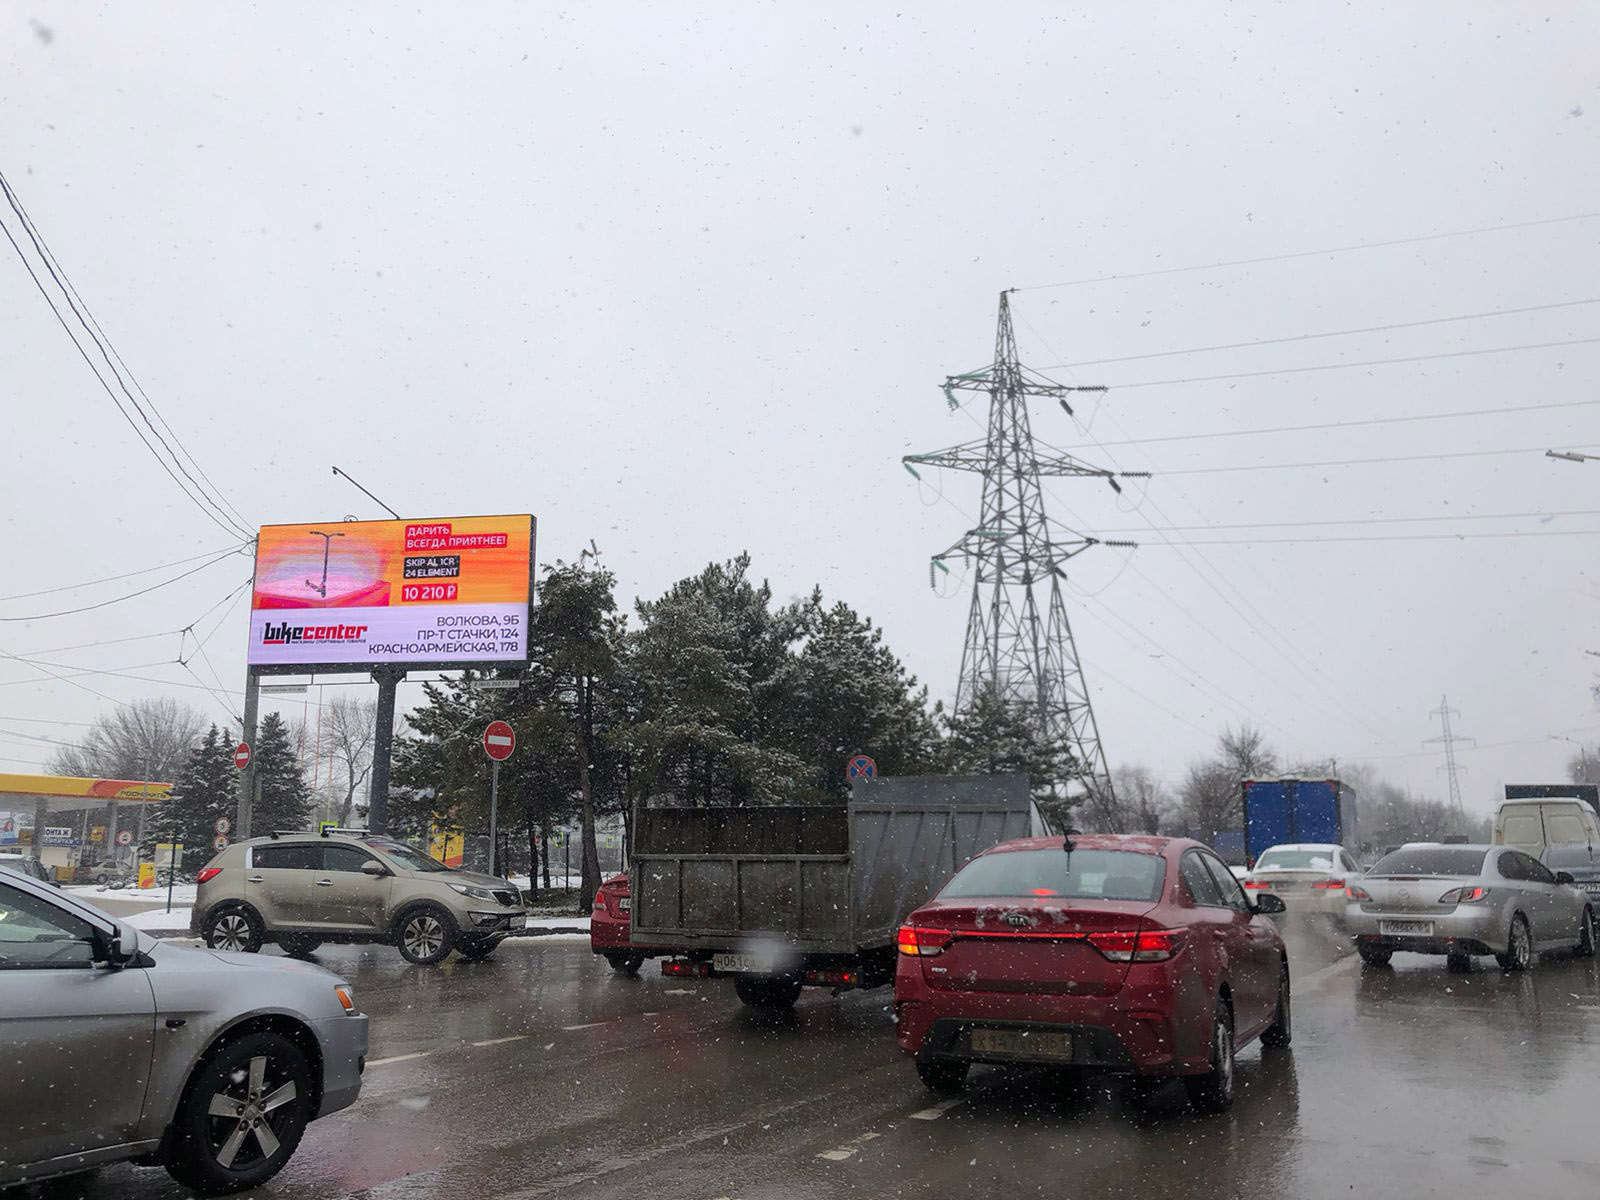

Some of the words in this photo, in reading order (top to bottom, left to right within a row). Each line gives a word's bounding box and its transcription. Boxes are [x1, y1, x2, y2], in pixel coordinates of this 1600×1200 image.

[407, 526, 450, 537] ДАРИТЬ
[406, 538, 447, 549] ВСЕГДА
[448, 535, 506, 547] ПРИЯТНЕЕ!
[406, 559, 426, 567] SKIP
[426, 558, 439, 566] AL
[405, 569, 416, 577] 24
[417, 567, 458, 577] ELEMENT
[404, 587, 419, 600] 10
[421, 586, 445, 599] 210
[437, 616, 501, 627] ВОЛКОВА,
[503, 615, 519, 625] 9Б
[264, 622, 367, 644] bikecenter
[417, 630, 445, 640] ПР-Т
[447, 629, 498, 640] СТАЧКИ,
[501, 628, 519, 639] 124
[368, 641, 498, 654] КРАСНОАРМЕЙСКАЯ,
[500, 641, 518, 652] 178
[1009, 916, 1026, 926] KIA
